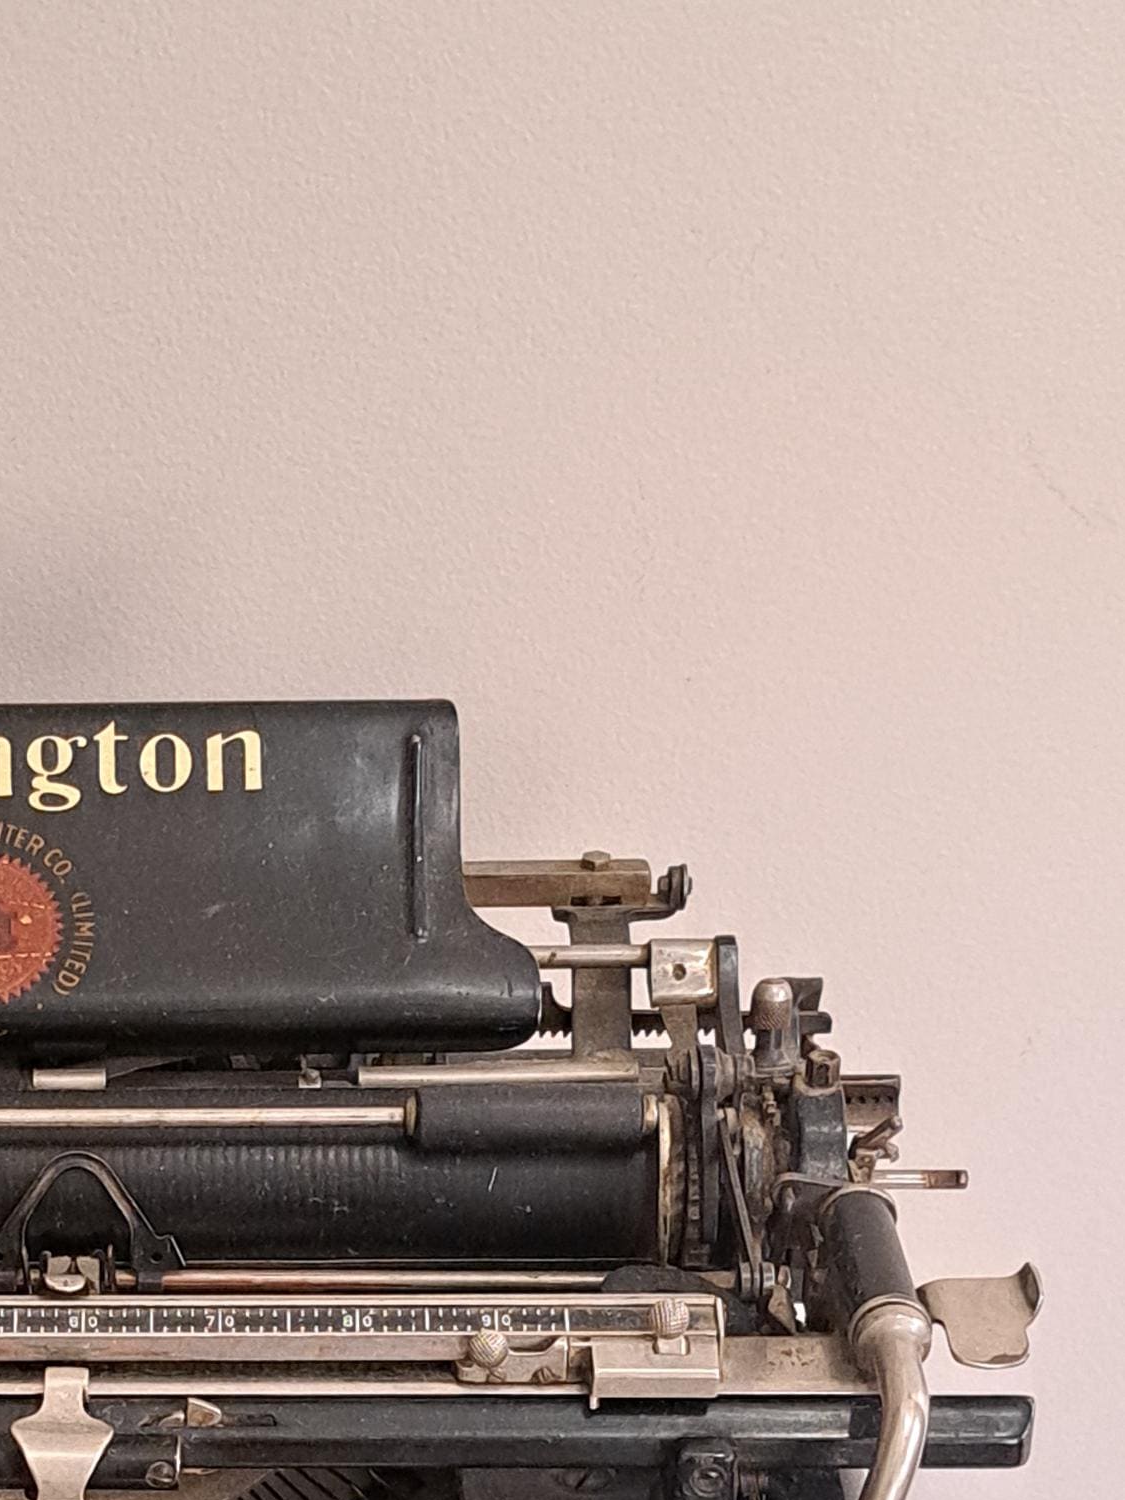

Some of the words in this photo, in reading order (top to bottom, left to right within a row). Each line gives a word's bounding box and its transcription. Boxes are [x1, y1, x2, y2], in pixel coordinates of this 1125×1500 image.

[43, 848, 73, 884] CO.
[51, 892, 96, 995] (LIMITED)
[69, 1314, 98, 1329] 60
[205, 1314, 235, 1328] 70
[343, 1314, 373, 1328] 80
[481, 1313, 512, 1328] 90
